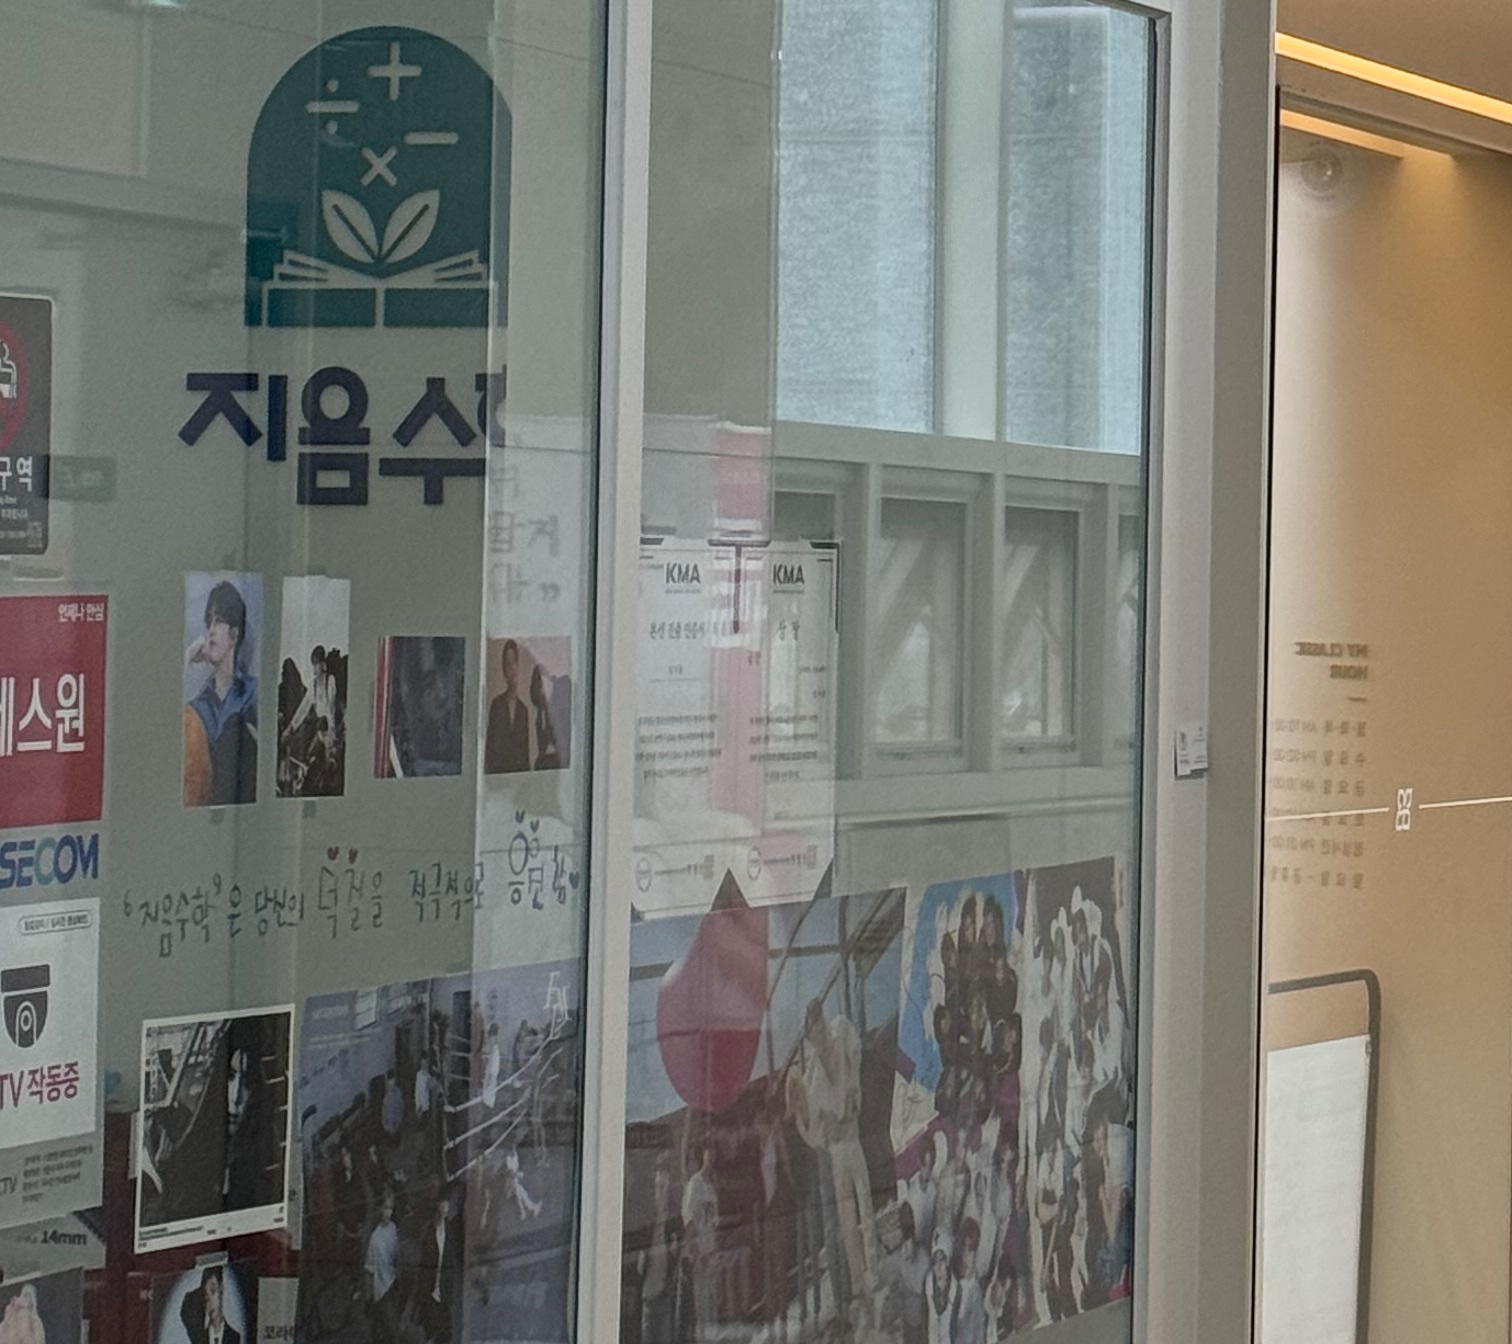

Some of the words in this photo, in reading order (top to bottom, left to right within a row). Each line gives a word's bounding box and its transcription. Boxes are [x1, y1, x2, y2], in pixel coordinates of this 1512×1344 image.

[665, 562, 701, 585] KMA
[773, 563, 805, 585] KMA
[27, 1061, 80, 1105] 작동중
[41, 1229, 87, 1245] 14mm
